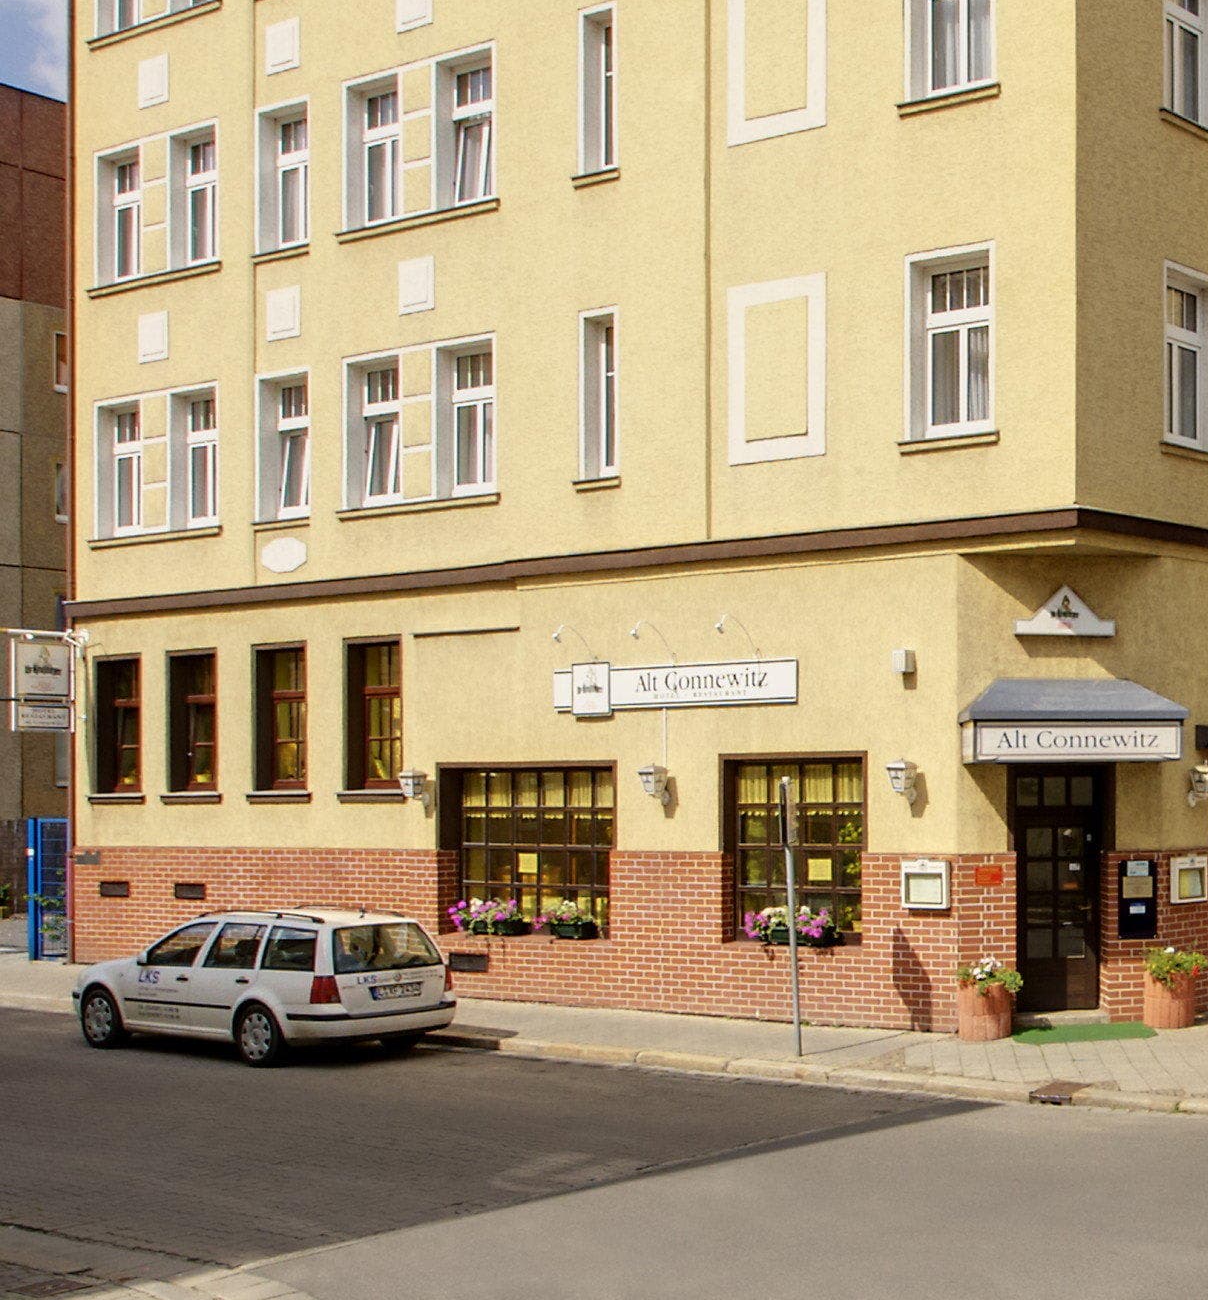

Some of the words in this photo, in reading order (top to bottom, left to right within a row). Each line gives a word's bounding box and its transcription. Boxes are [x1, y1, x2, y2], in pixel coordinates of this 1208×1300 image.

[635, 672, 658, 693] Alt
[664, 667, 768, 692] Connewitz
[997, 729, 1028, 749] Alt
[1036, 729, 1159, 750] Connewitz
[138, 969, 160, 984] LKS
